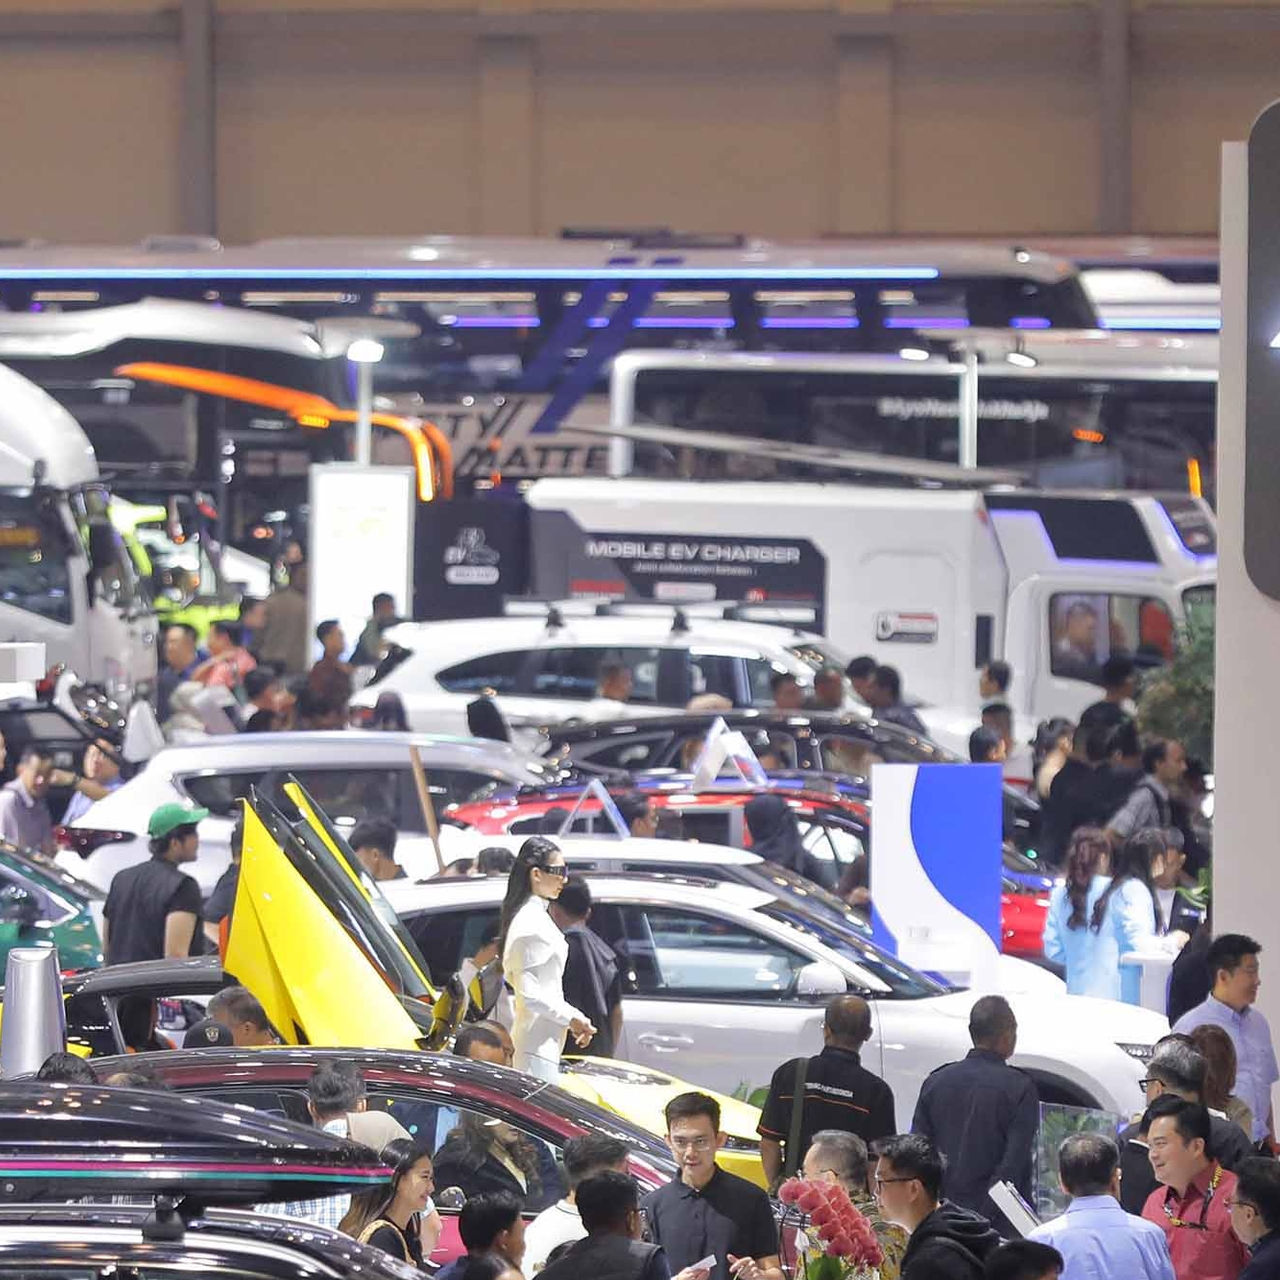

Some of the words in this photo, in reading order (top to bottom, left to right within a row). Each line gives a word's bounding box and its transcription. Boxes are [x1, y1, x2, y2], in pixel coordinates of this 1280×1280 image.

[586, 541, 665, 560] MOBILE
[669, 543, 700, 560] EV
[703, 545, 801, 563] CHARGER
